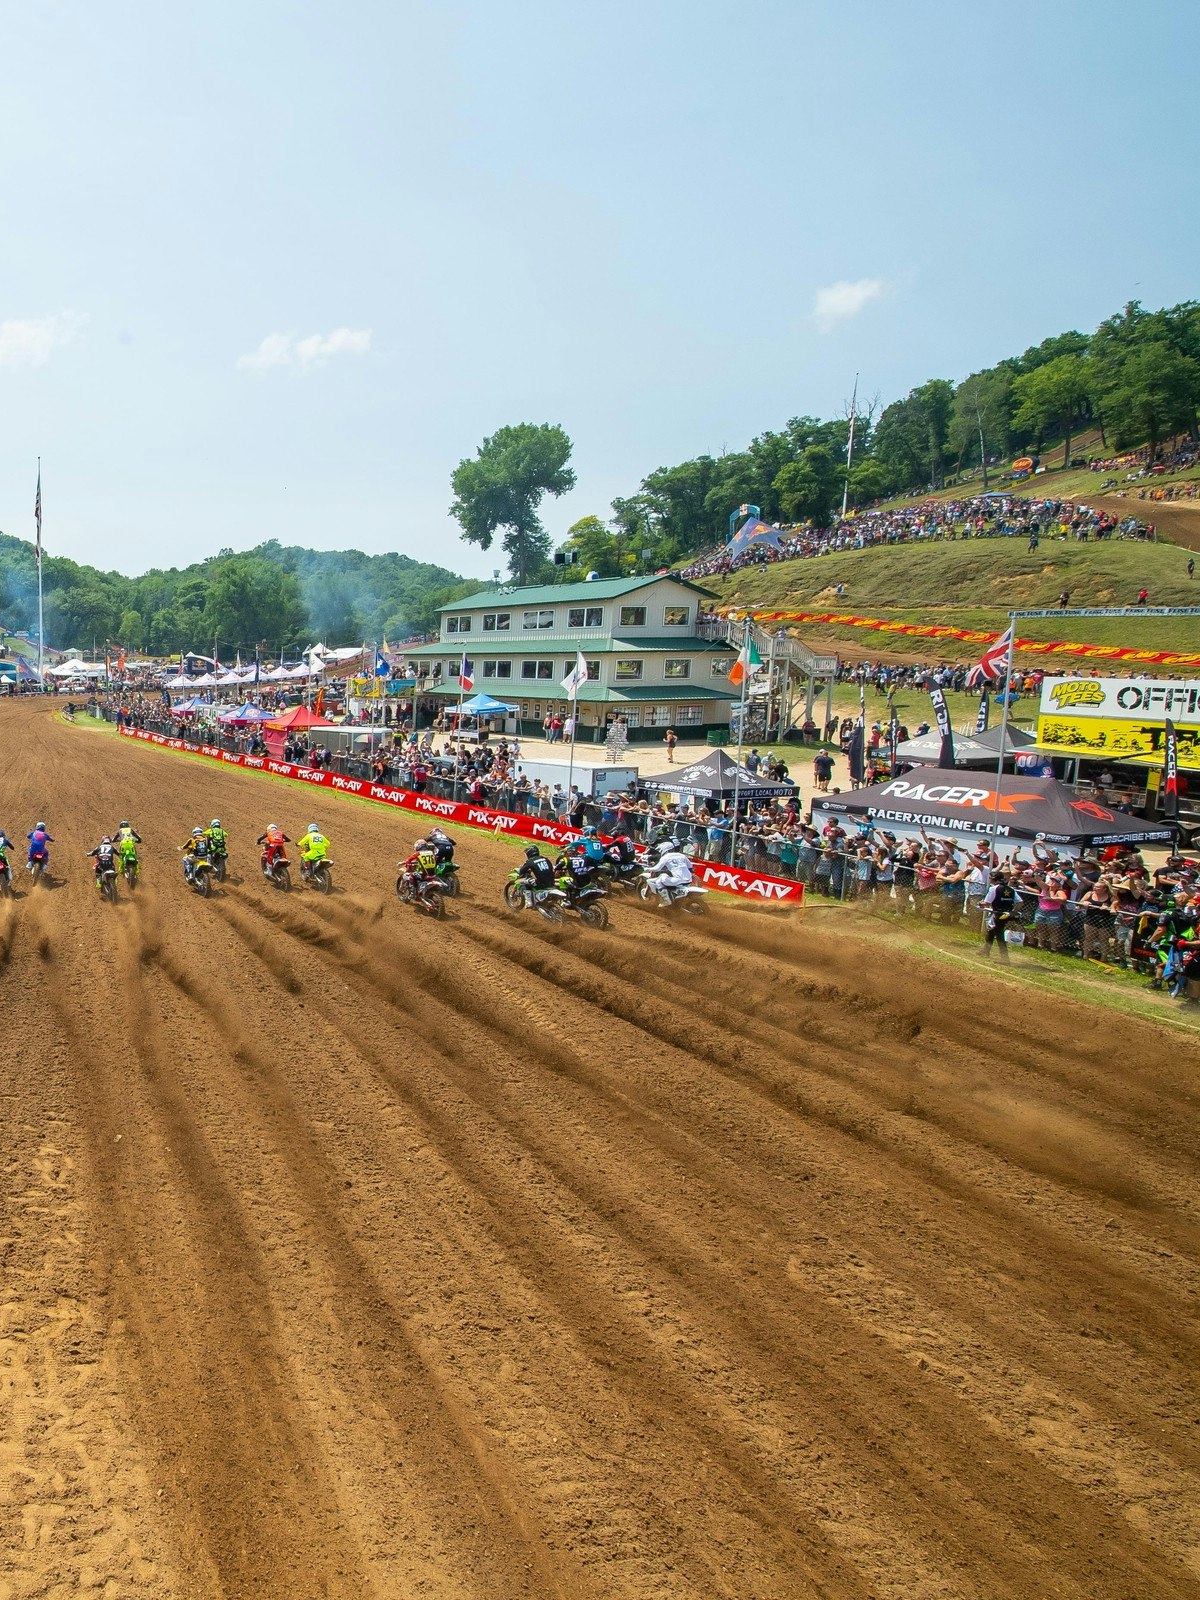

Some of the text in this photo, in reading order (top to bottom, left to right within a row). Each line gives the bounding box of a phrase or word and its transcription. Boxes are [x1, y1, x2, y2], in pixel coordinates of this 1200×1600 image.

[1049, 680, 1101, 701] MOTO
[1056, 691, 1106, 710] TEES
[370, 786, 386, 798] MX
[388, 791, 406, 802] ATV
[731, 790, 754, 798] SPPORT
[774, 788, 793, 796] MOTO
[416, 797, 432, 812] MX
[436, 804, 456, 816] ATV
[468, 810, 489, 824] MX
[492, 815, 518, 829] ATV
[868, 808, 1010, 836] RACERXONLINE.COM
[532, 823, 557, 838] MX
[1092, 830, 1172, 844] SUBSCRIBE HERE!
[702, 868, 741, 890] MX
[744, 880, 794, 899] ATV
